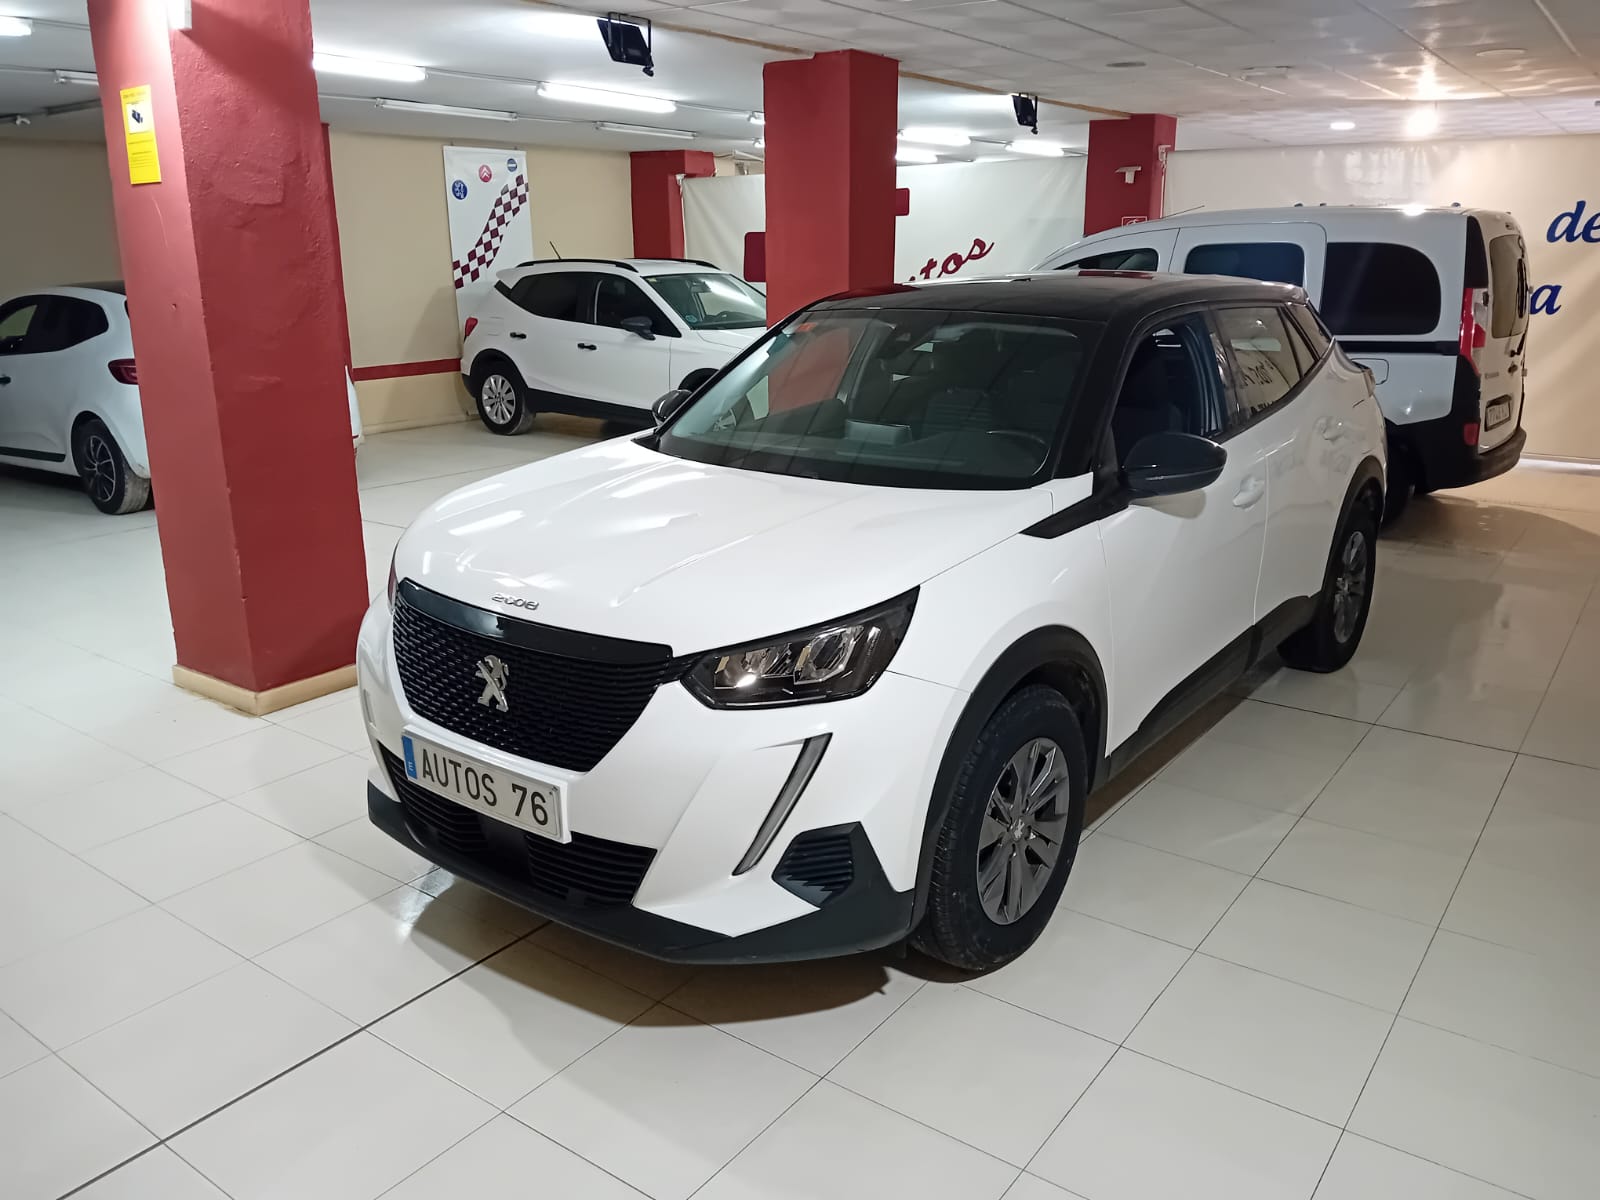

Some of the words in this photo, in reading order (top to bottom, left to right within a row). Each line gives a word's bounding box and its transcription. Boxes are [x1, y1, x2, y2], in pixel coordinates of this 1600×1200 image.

[908, 238, 995, 281] tos
[491, 593, 540, 611] 2008
[422, 748, 498, 808] AUTOS
[511, 782, 549, 826] 76
